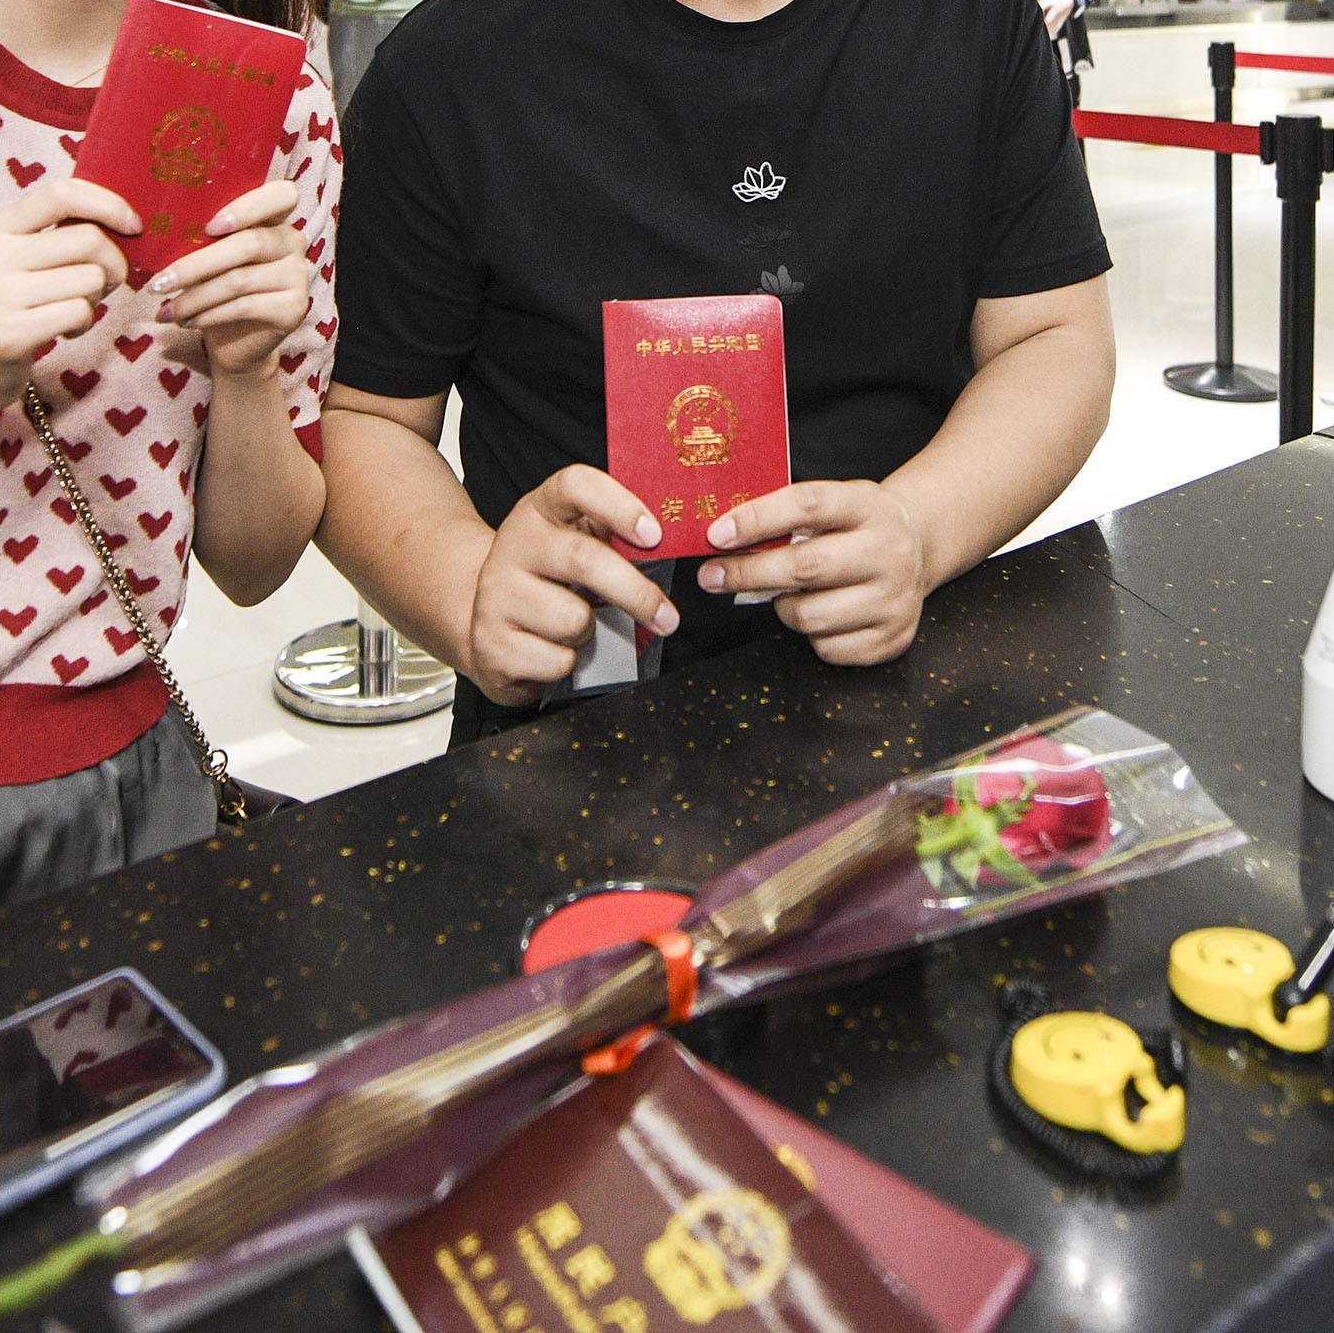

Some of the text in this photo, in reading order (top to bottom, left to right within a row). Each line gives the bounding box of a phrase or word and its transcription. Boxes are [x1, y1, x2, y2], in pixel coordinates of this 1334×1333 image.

[635, 333, 762, 358] 中华人民共和国
